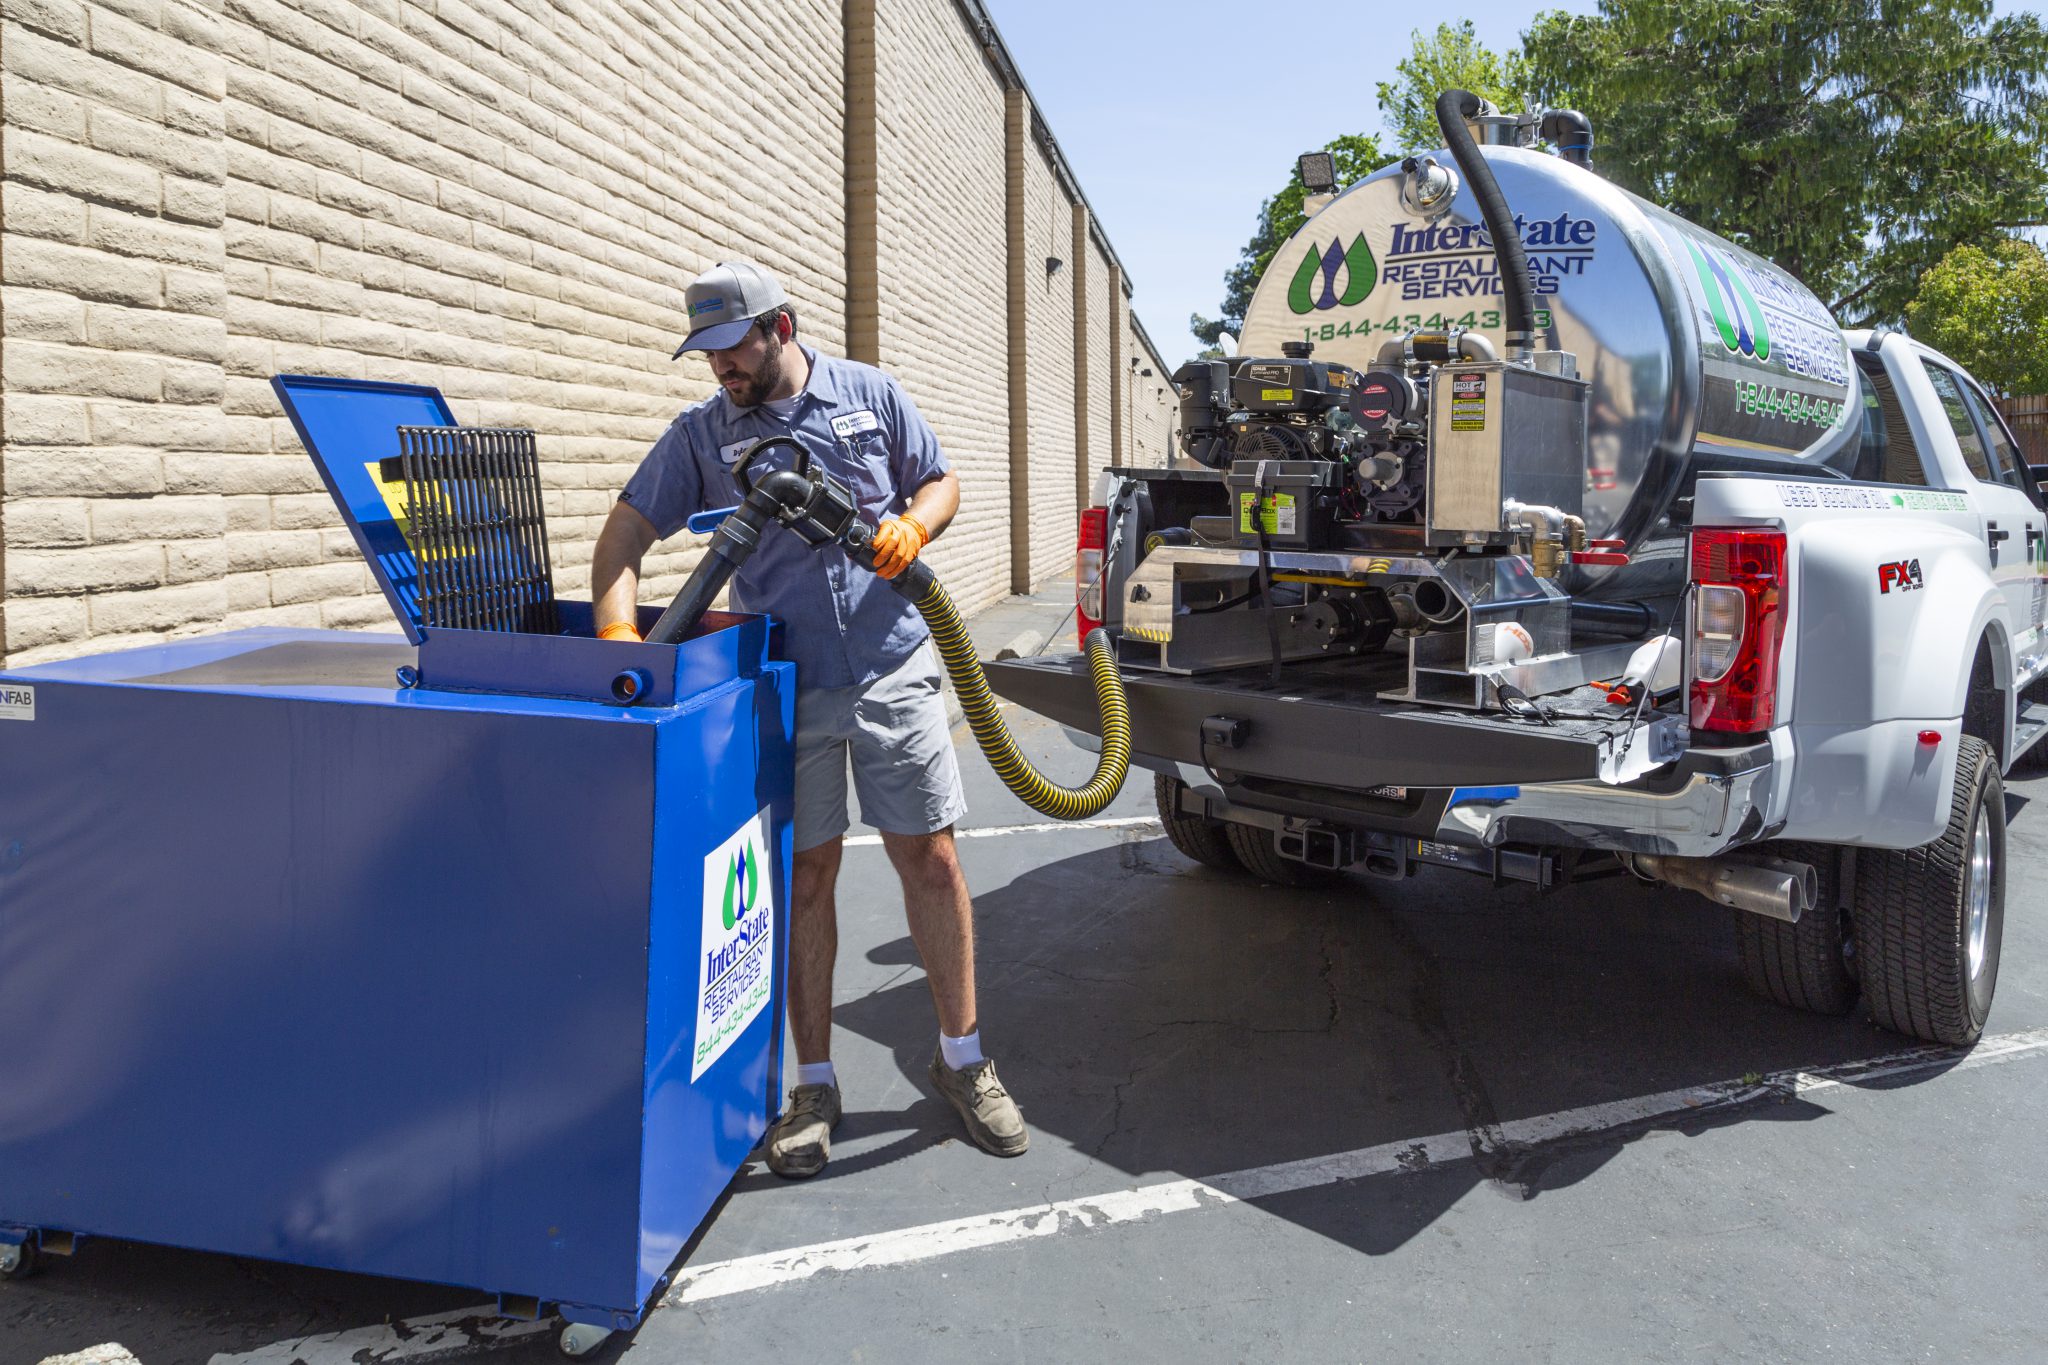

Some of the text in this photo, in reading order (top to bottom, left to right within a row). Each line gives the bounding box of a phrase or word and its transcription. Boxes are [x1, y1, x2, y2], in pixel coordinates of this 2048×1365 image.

[1382, 256, 1593, 285] RESTAUANT
[1401, 276, 1560, 300] SERVICS
[1304, 308, 1551, 342] 1-844-434-433
[1784, 343, 1843, 385] SERVICES
[1735, 380, 1845, 431] 1-844-434-4343
[1878, 558, 1923, 594] FX4
[705, 907, 769, 989] InterState
[703, 936, 769, 1015] RESTAURANT
[711, 961, 761, 1024] SERVICES
[696, 975, 769, 1065] 844-434-4343
